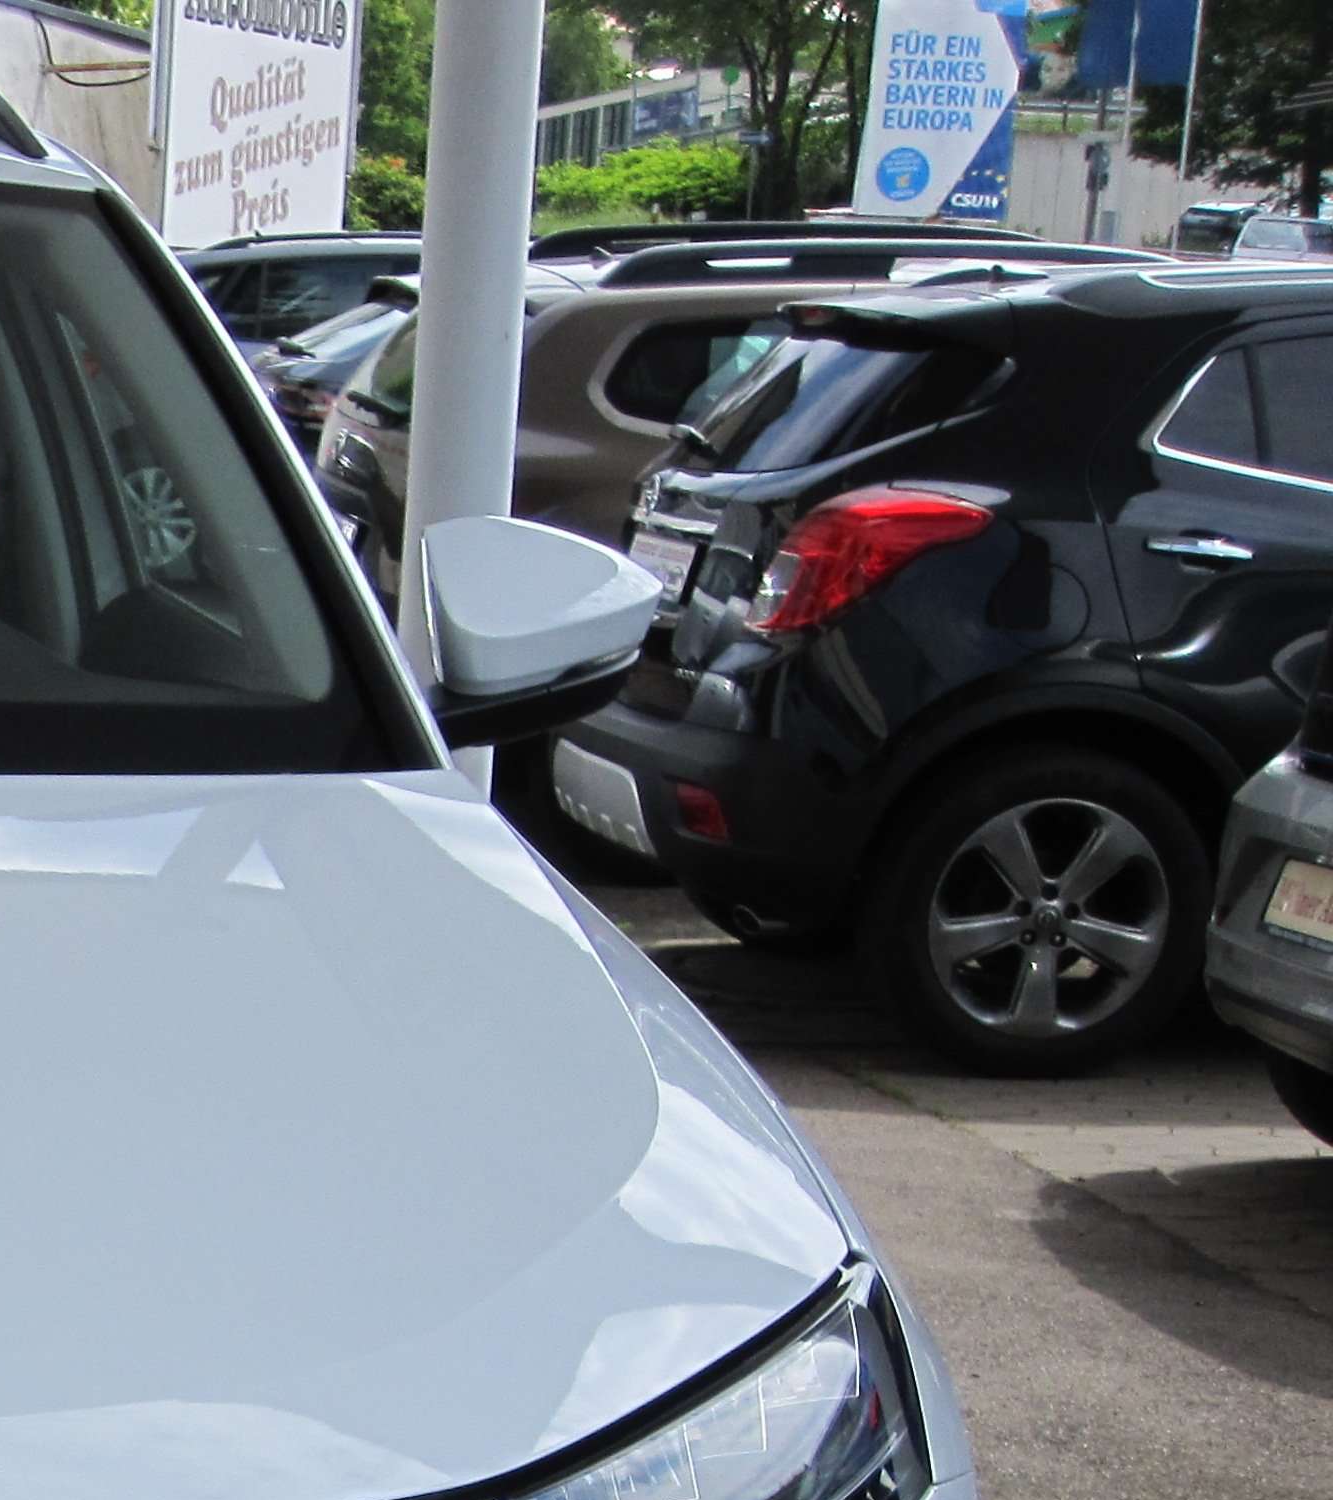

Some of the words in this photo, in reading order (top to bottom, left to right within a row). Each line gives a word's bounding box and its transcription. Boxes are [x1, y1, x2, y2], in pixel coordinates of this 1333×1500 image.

[891, 30, 936, 56] FÜR
[946, 36, 981, 57] EIN
[887, 60, 986, 83] STARKES
[210, 56, 306, 133] Qualität
[885, 84, 975, 107] BAYERN
[983, 88, 1004, 109] IN
[883, 108, 973, 132] EUROPA
[174, 150, 223, 195] zum
[231, 113, 341, 188] günstigen
[232, 178, 289, 235] Preis
[951, 192, 983, 208] CSU
